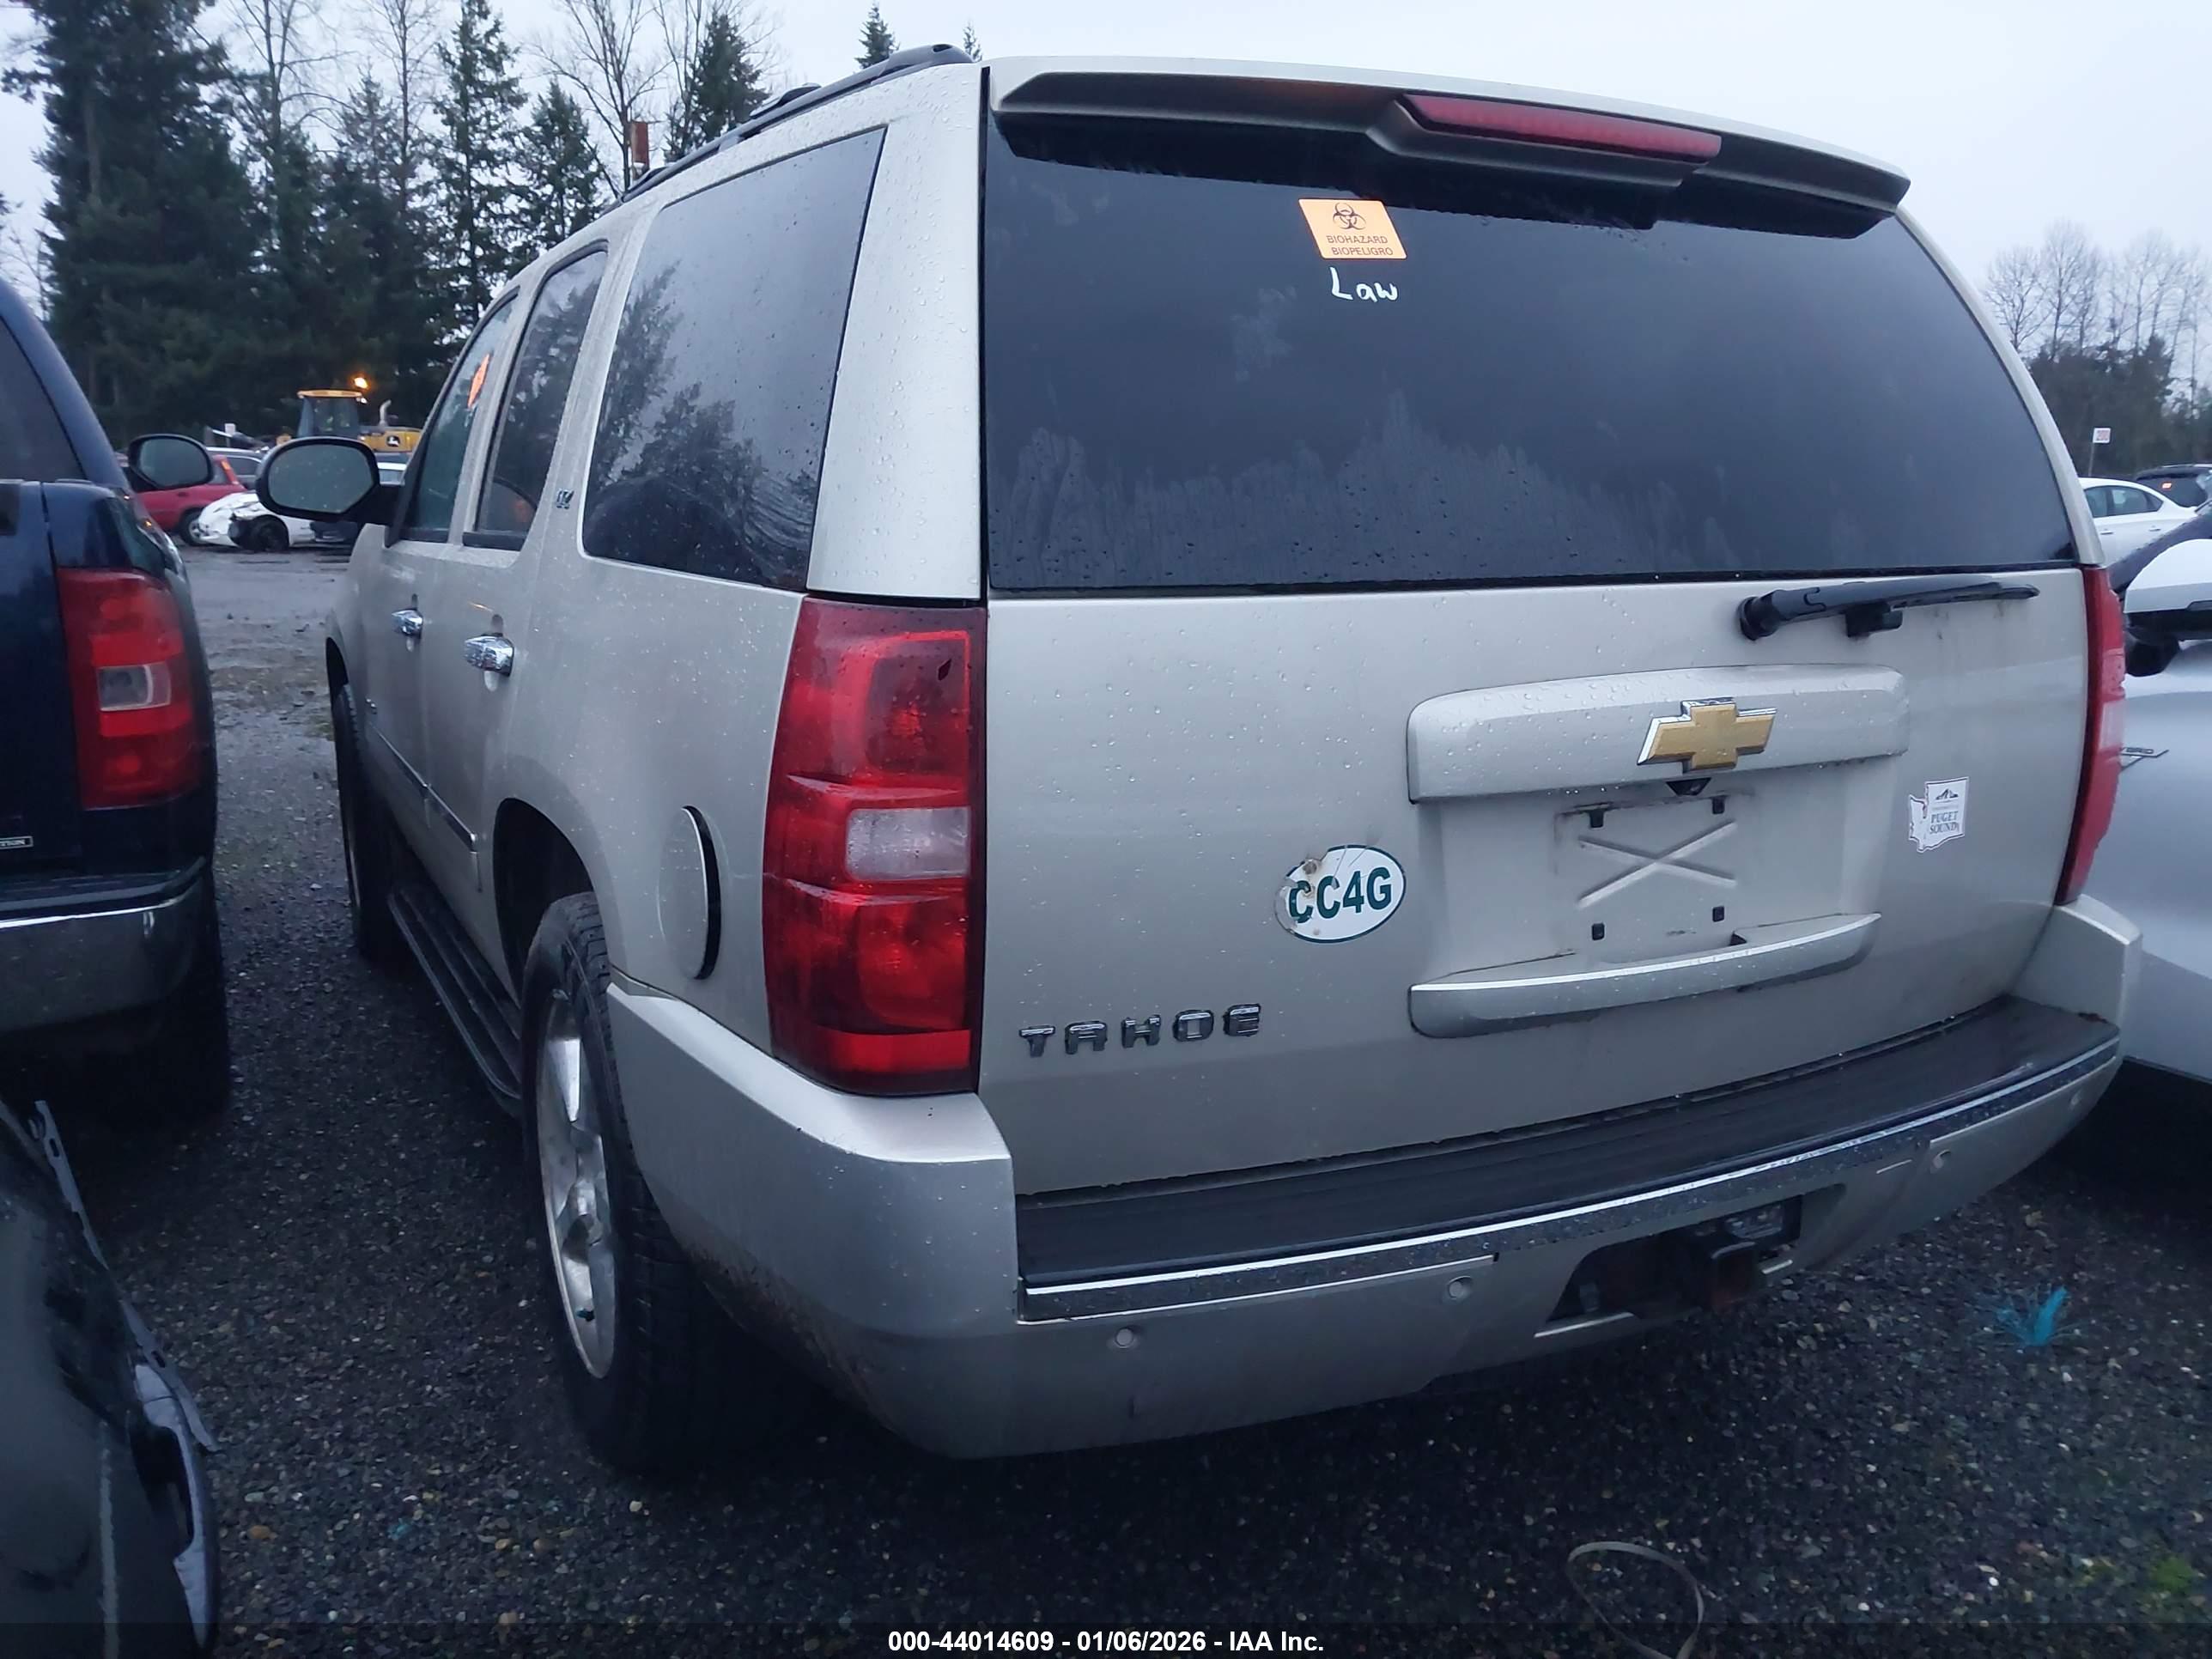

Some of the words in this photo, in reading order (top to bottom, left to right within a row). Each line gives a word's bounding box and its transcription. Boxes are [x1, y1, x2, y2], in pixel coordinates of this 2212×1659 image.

[1326, 235, 1389, 244] BIOHAZARD
[1331, 247, 1394, 256] BIOPELIGRO
[1329, 266, 1398, 302] Law
[1930, 811, 1959, 823] PUGET
[1929, 822, 1959, 834] SOUND
[1288, 866, 1392, 924] CC4G
[1018, 1003, 1261, 1057] TAHOE
